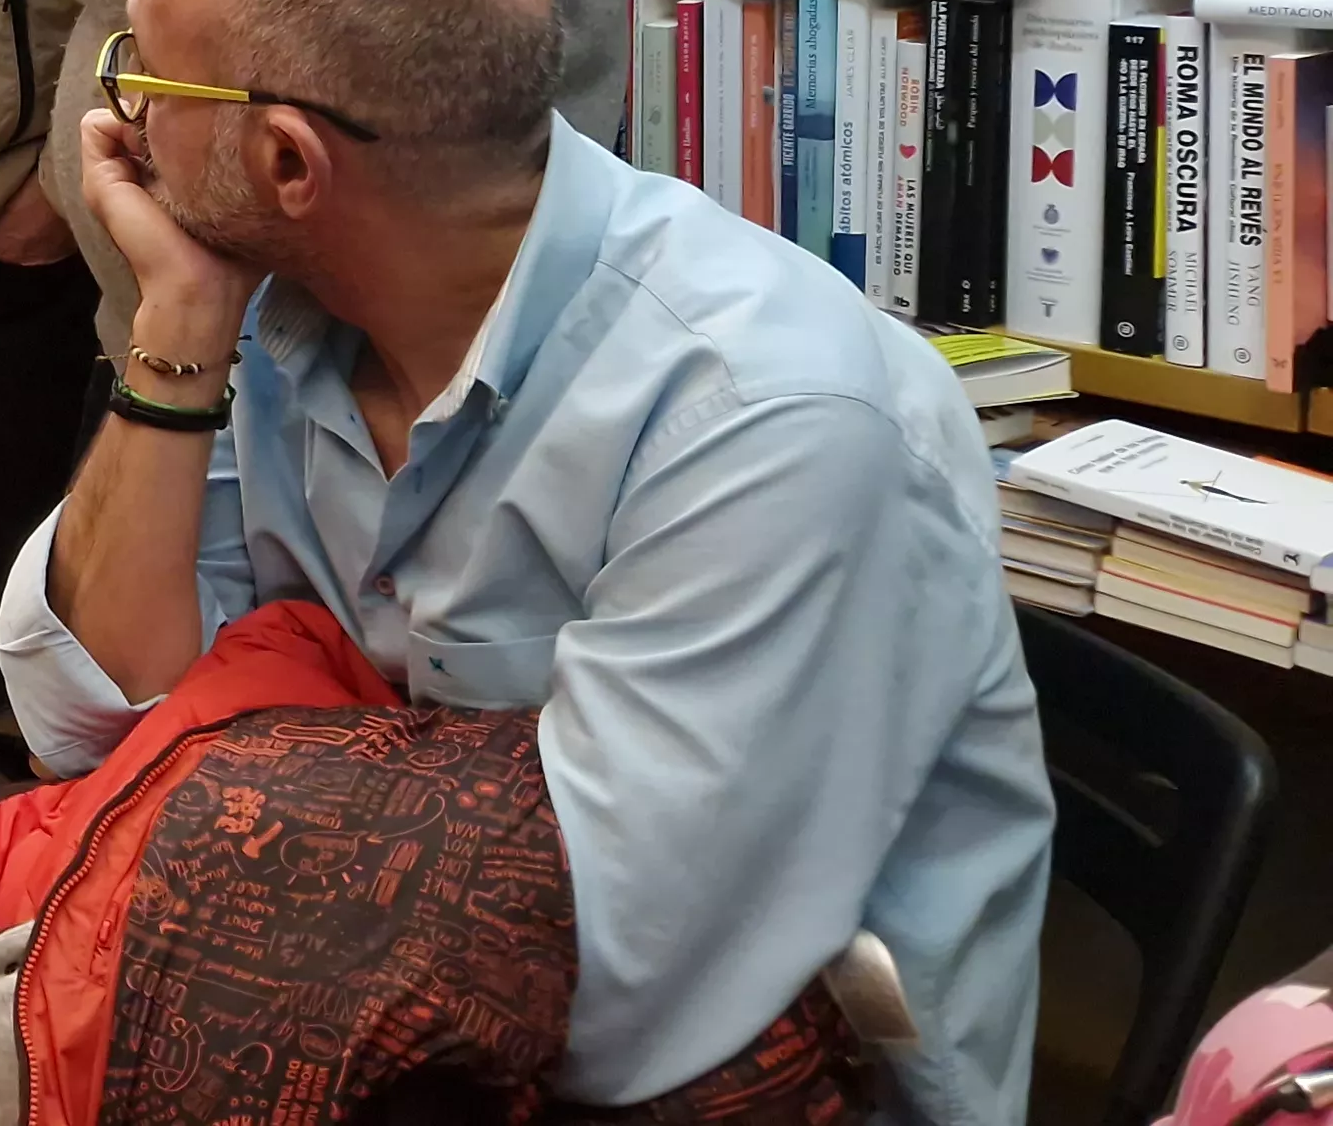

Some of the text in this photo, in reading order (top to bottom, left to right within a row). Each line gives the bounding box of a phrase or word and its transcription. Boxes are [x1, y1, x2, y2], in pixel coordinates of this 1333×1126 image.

[804, 53, 818, 110] Memorias
[844, 29, 855, 98] JAMES CLEAR
[899, 67, 910, 127] NORWOOD
[909, 78, 920, 114] ROBIN
[781, 93, 795, 166] VICENTE GARRIDO
[1175, 44, 1199, 234] ROMA OSCURA
[1239, 53, 1268, 246] EL MUNDO AL REVÉS
[839, 121, 853, 233] ábitos atómicos
[893, 175, 905, 276] AMAN DEMASIADO
[903, 178, 916, 275] LAS MUJERES QUE
[1166, 249, 1179, 312] SOMMER
[1184, 252, 1198, 313] MICHAEL
[1227, 260, 1241, 326] JISHENG
[1246, 264, 1261, 307] YANG
